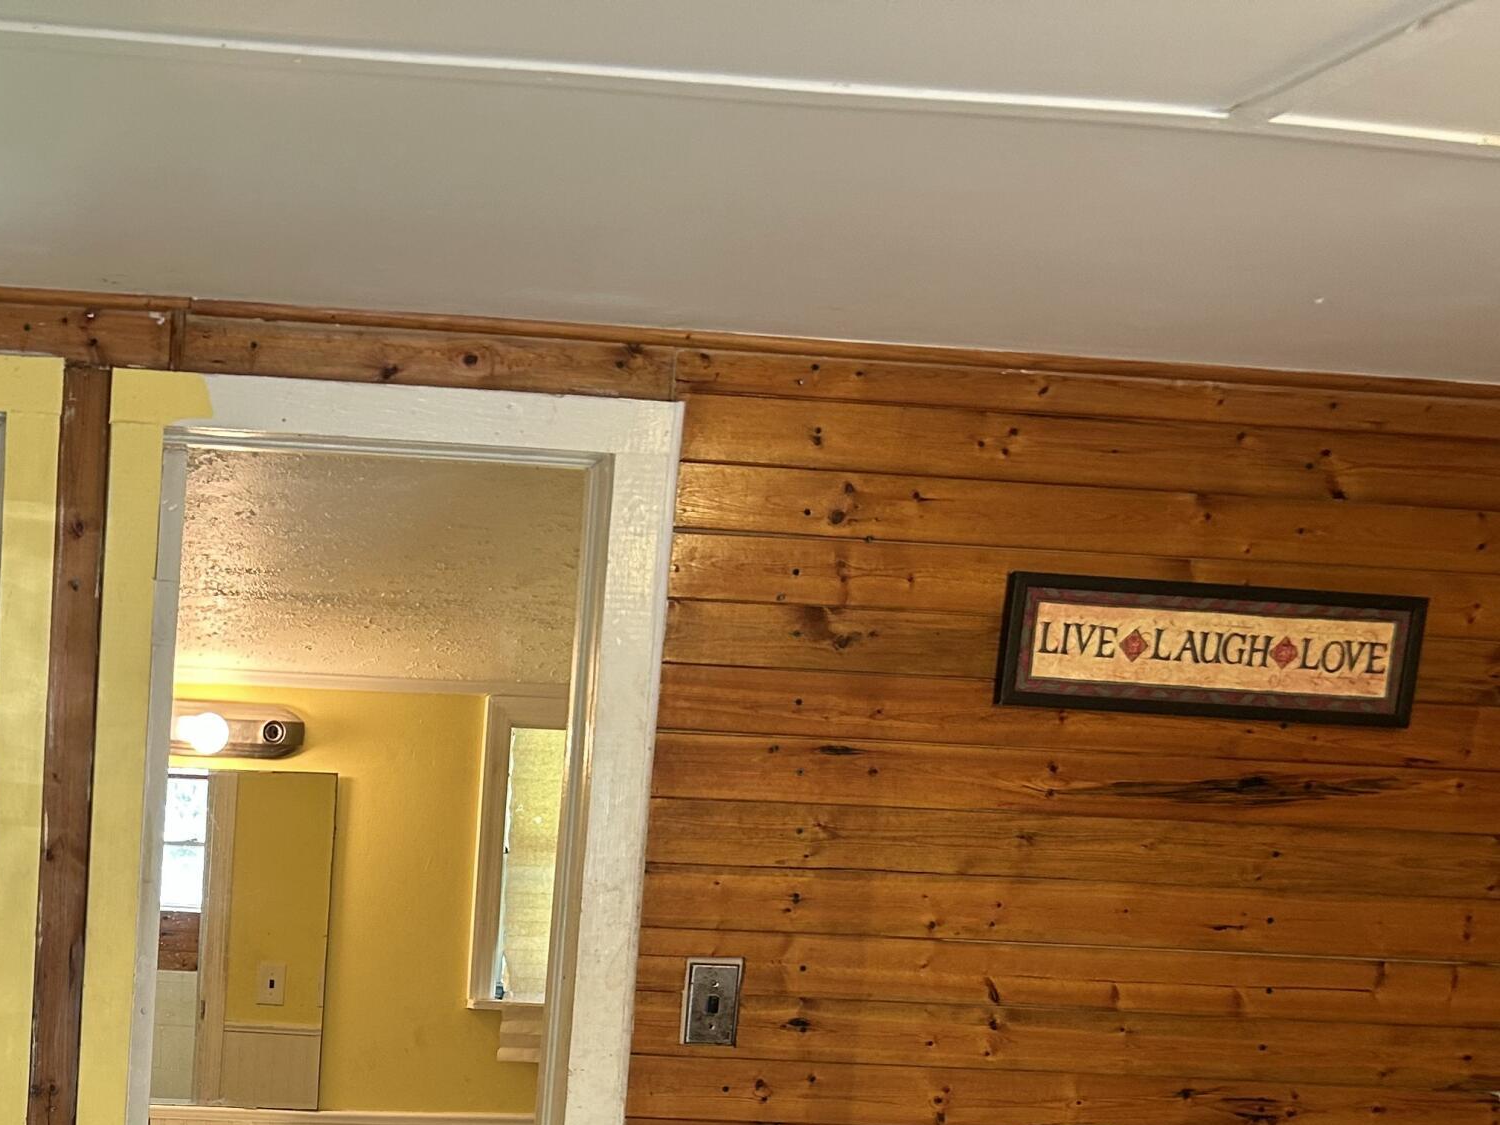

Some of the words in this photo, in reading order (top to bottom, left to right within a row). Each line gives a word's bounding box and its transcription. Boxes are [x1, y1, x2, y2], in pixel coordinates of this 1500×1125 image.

[1038, 622, 1118, 658] LIVE
[1150, 627, 1273, 669] LAUGH
[1298, 637, 1388, 675] LOVE
